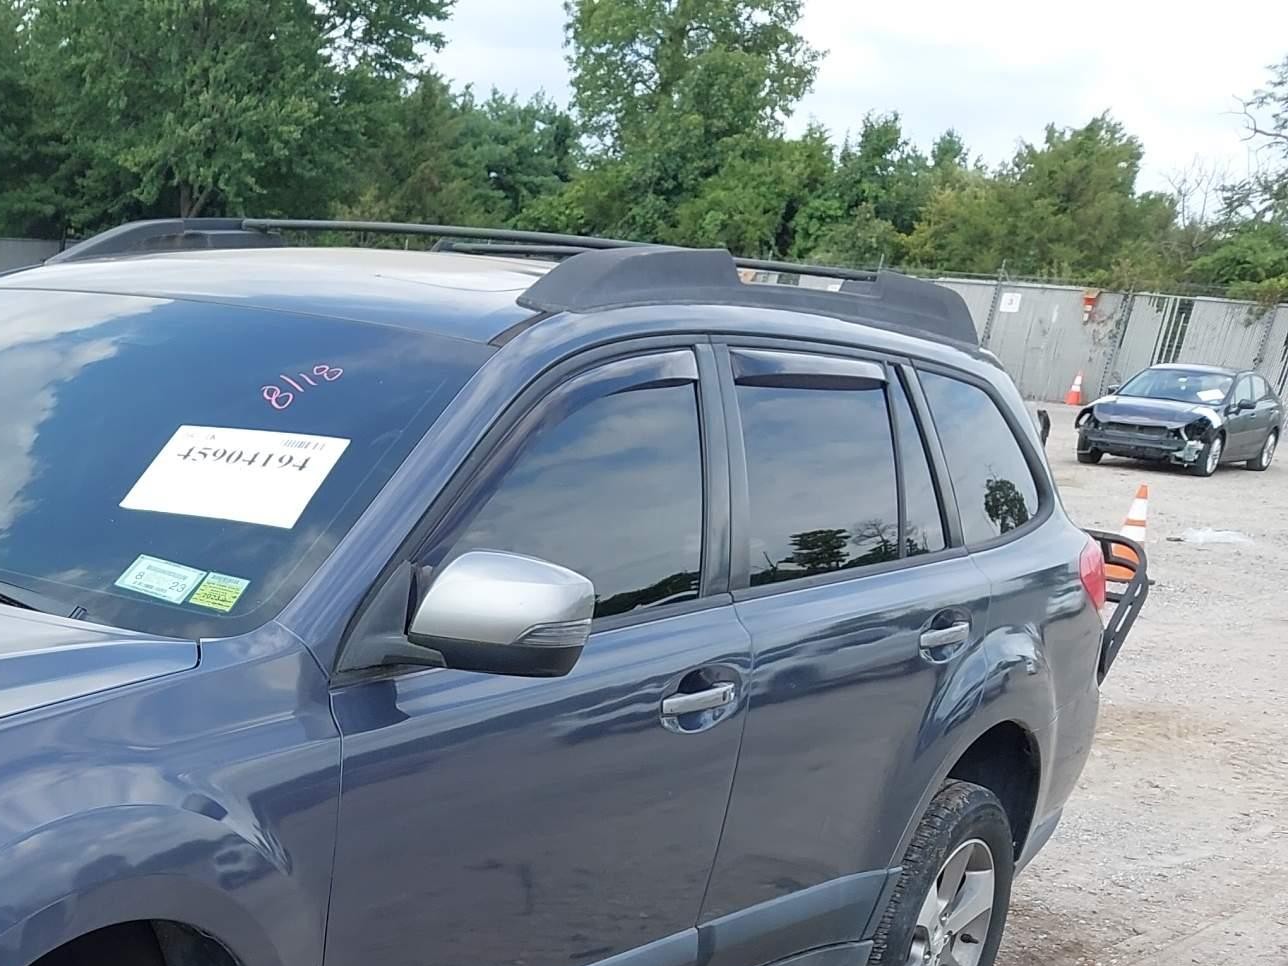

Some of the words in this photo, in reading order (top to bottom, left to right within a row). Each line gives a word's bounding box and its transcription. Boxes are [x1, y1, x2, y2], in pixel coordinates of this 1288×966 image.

[176, 446, 312, 472] 45904194
[135, 571, 146, 580] 8
[168, 581, 188, 593] 23
